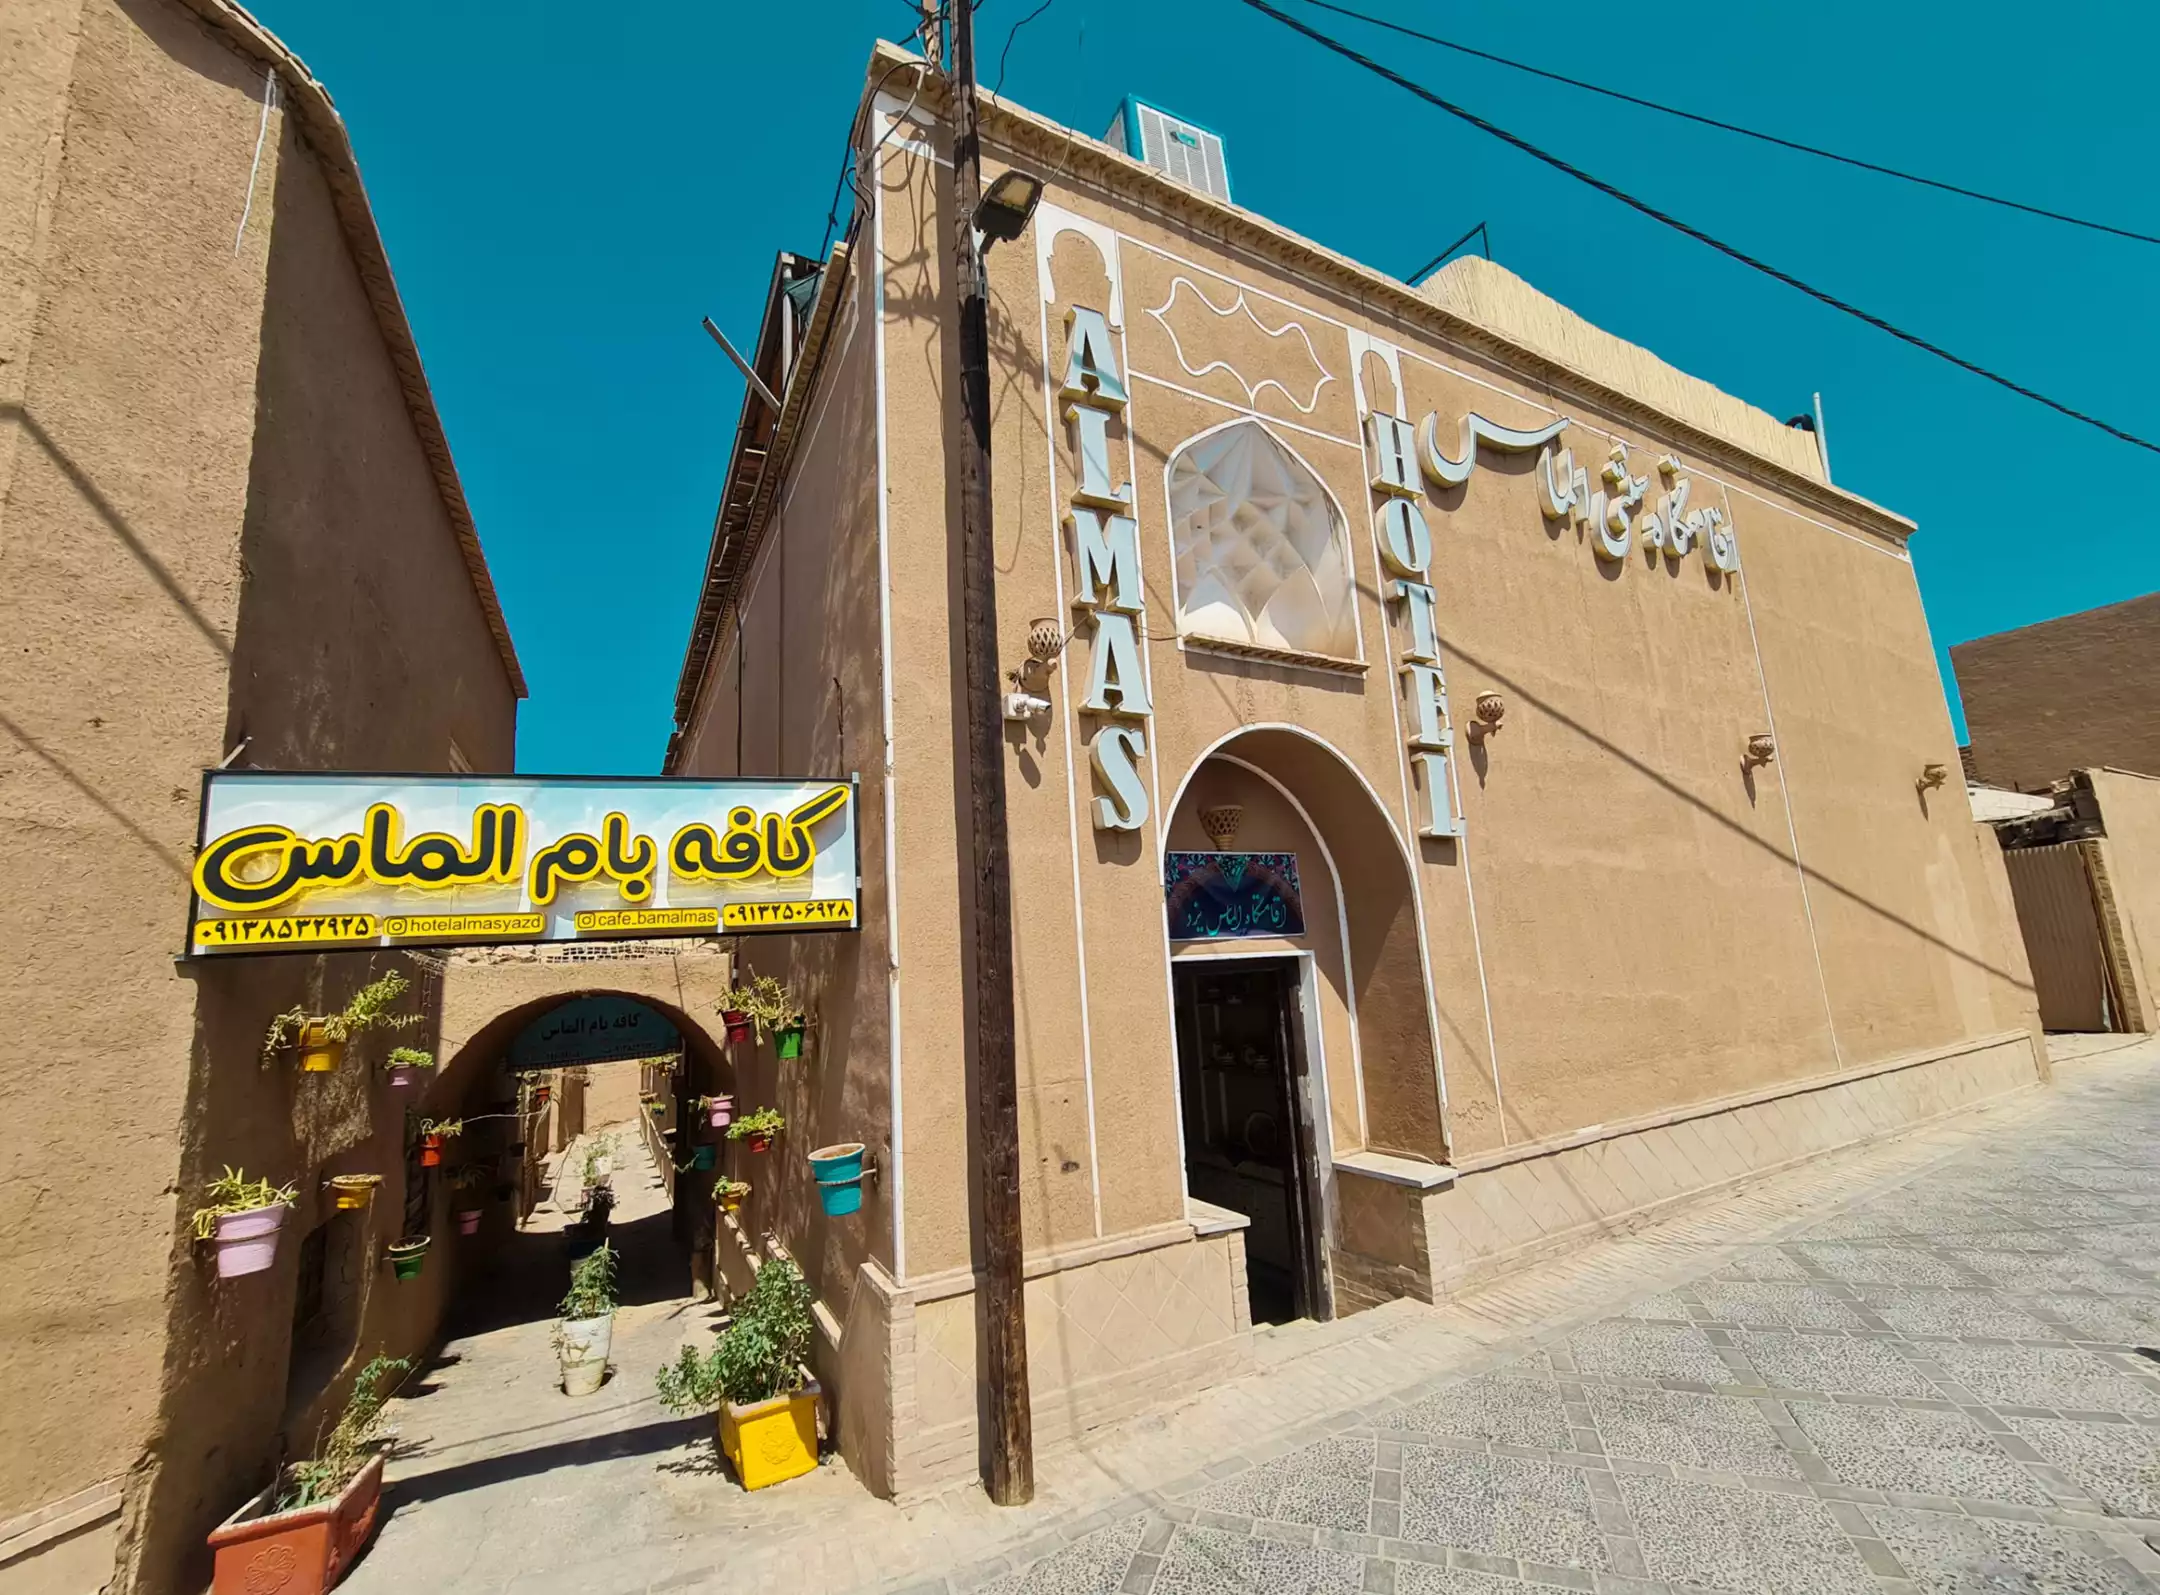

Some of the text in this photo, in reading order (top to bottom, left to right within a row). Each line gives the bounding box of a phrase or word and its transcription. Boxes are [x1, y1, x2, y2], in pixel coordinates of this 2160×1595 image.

[1058, 303, 1154, 832] ALMAS
[1363, 410, 1467, 838] HOTEL
[193, 784, 850, 912] کافه بام الماس
[410, 915, 541, 934] hotelalmasyazd
[598, 909, 715, 927] cafe_bamalmas
[540, 1012, 642, 1041] کافه بام الماس
